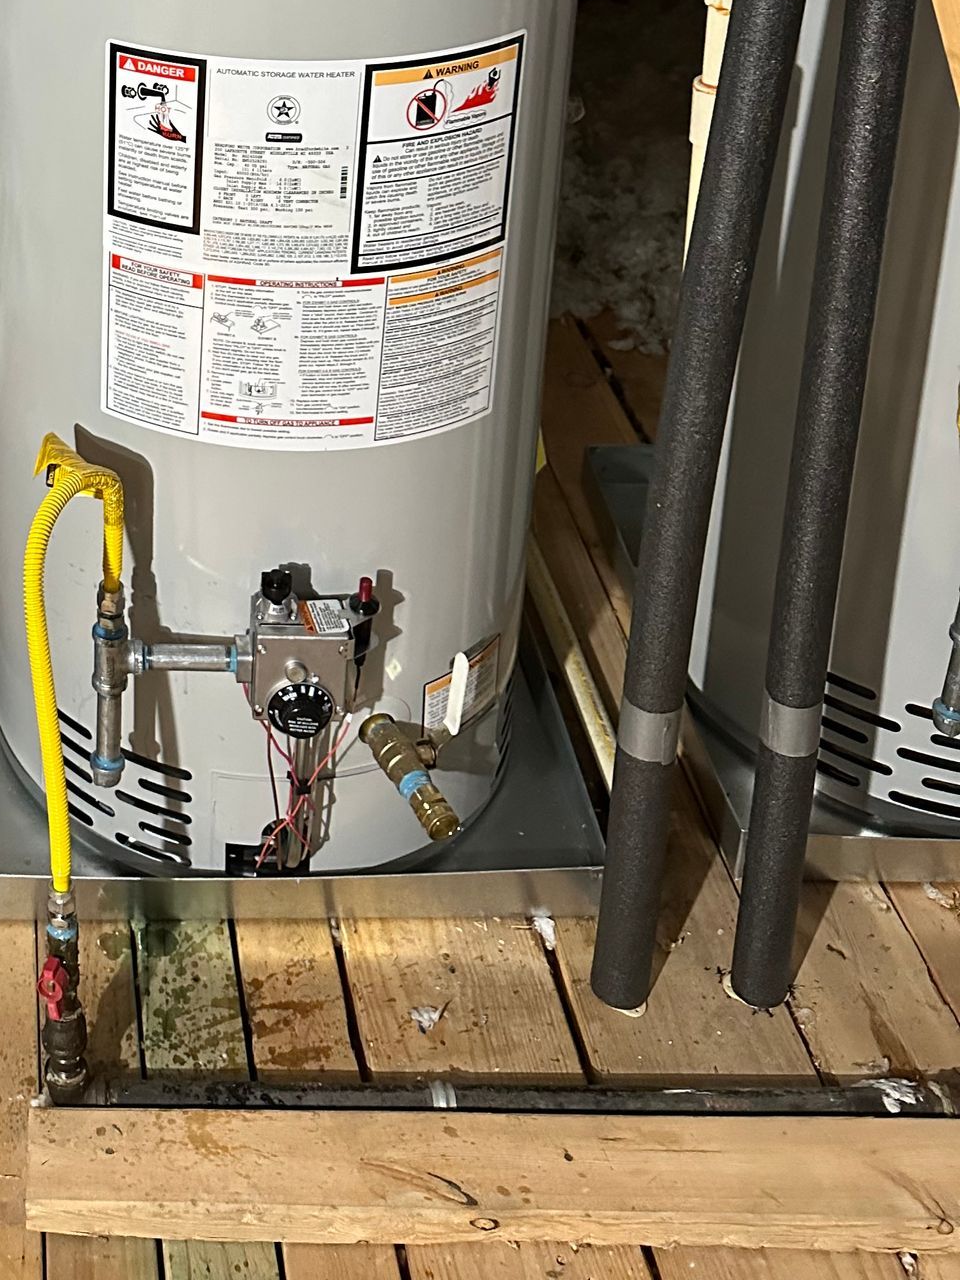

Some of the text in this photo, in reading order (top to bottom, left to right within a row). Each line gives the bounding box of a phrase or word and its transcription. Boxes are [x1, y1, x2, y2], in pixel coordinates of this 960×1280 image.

[137, 61, 184, 77] DANGER
[436, 60, 479, 76] WARNING
[430, 133, 461, 144] EXPLOSION
[462, 128, 482, 137] HAZARD
[122, 264, 190, 285] READ BEFORE OPERATING
[159, 269, 180, 277] SAFETY
[260, 280, 293, 288] OPERATING
